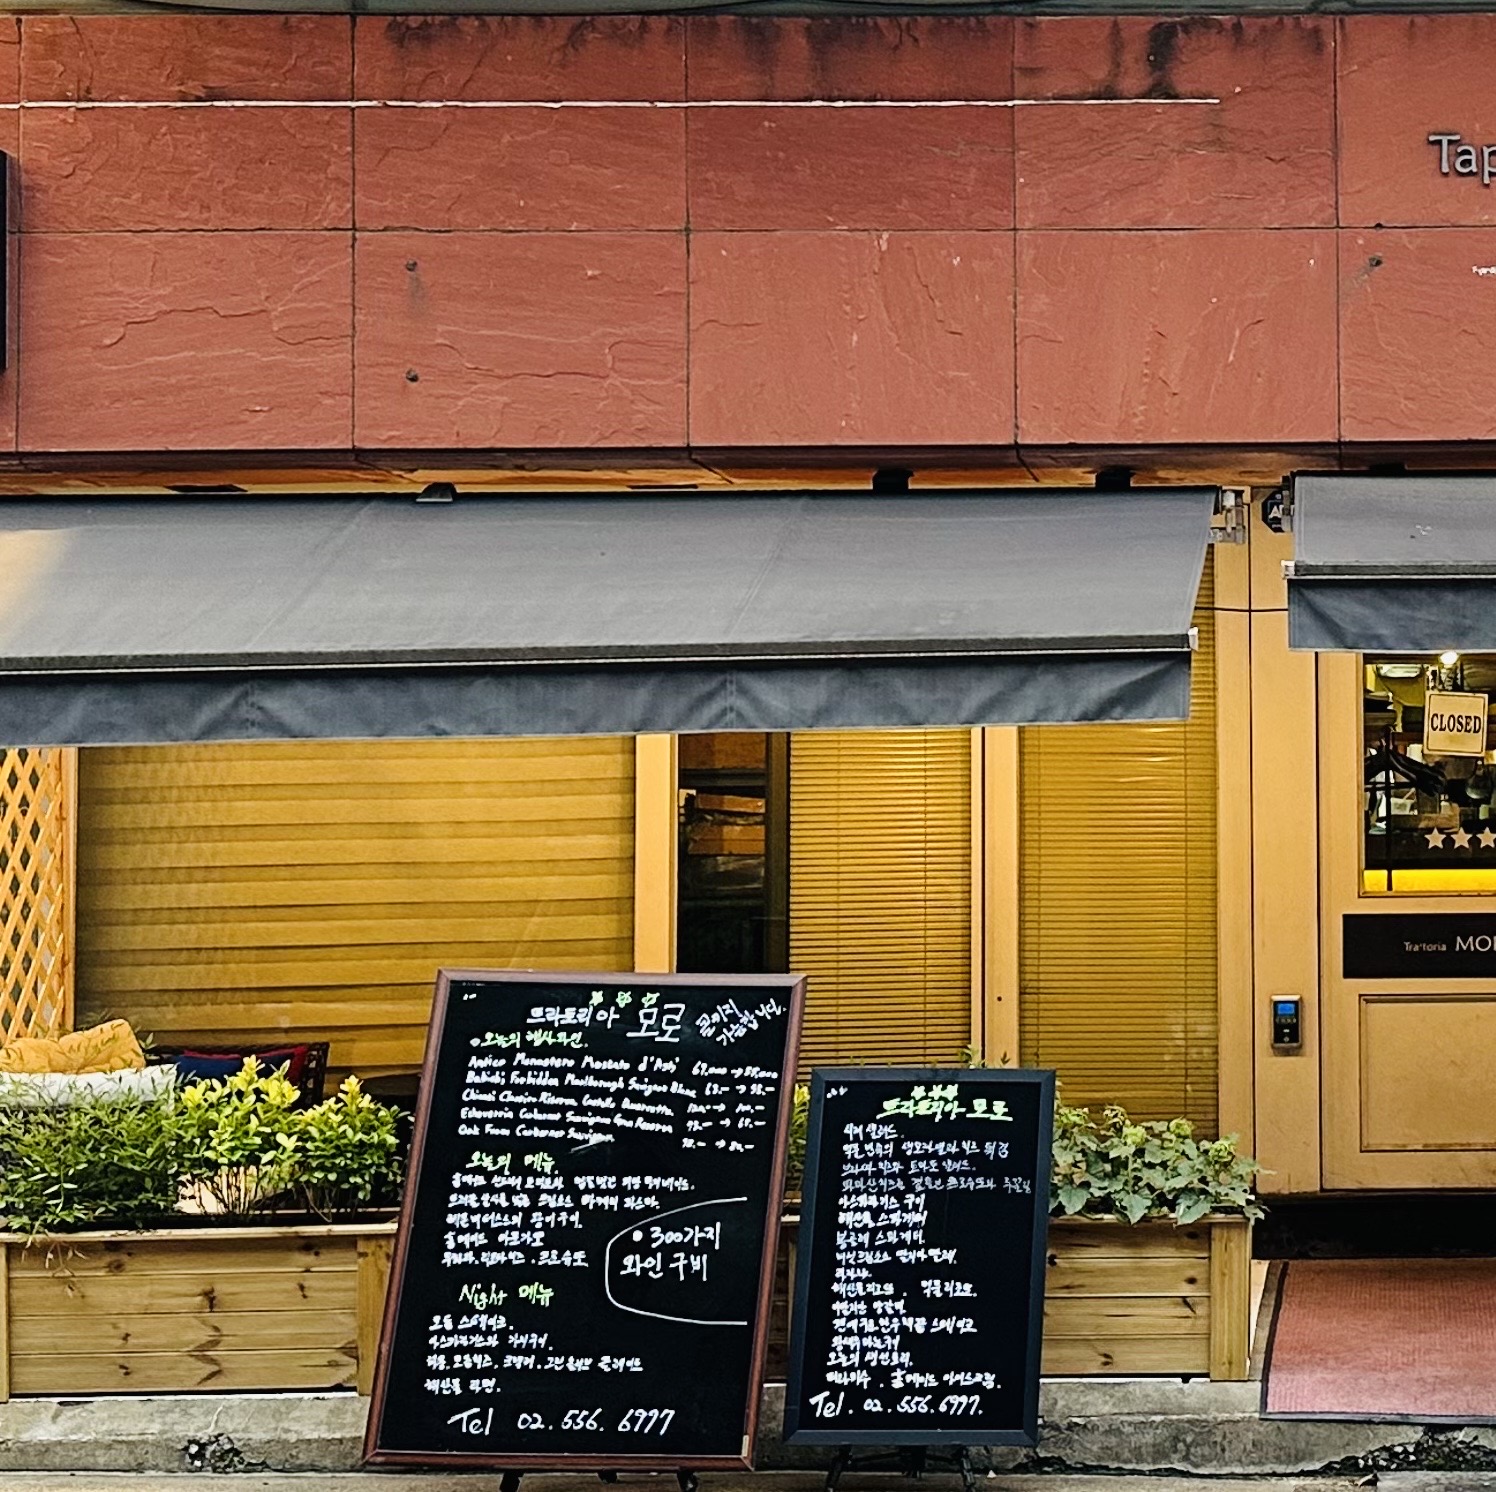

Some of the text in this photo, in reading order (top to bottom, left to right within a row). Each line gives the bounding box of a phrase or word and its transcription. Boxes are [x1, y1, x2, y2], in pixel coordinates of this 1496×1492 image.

[1430, 712, 1483, 735] CLOSED
[626, 1003, 686, 1042] 모로
[966, 1098, 1014, 1122] 모로
[465, 1151, 512, 1175] 오늘의
[619, 1251, 709, 1282] 와인 구비
[458, 1281, 555, 1311] Night 메뉴
[446, 1406, 494, 1436] Tel
